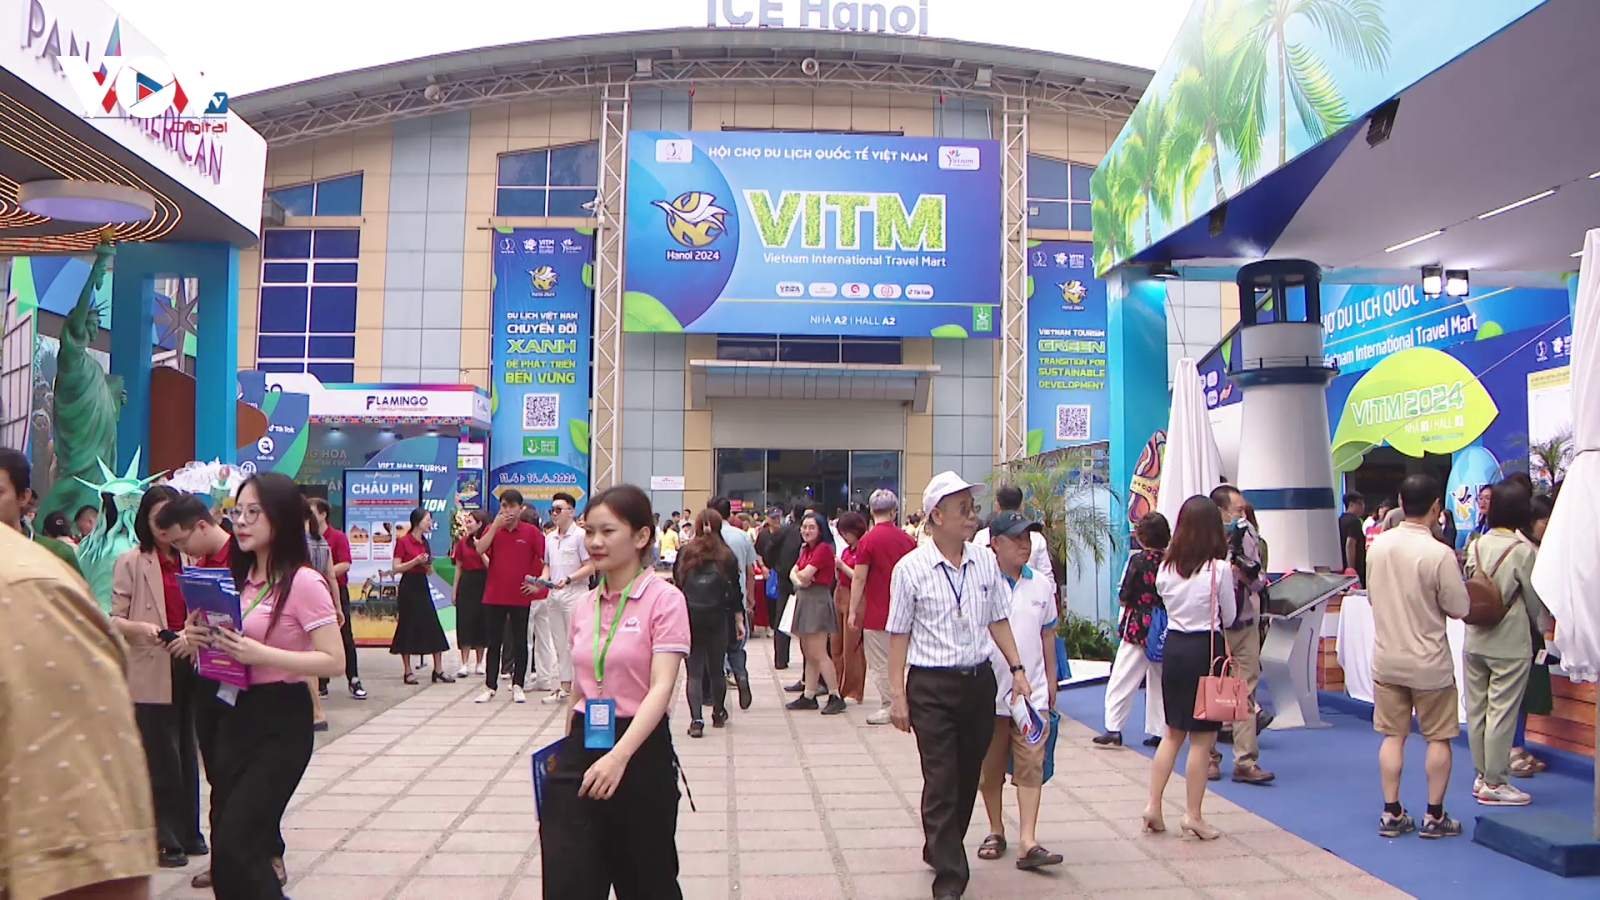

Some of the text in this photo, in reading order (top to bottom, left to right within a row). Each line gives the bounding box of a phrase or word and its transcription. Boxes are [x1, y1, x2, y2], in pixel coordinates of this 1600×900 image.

[799, 0, 919, 35] Hanoi
[708, 144, 929, 164] HỘI CHỢ DU LỊCH QUỐC TẾ VIỆT NAM
[742, 188, 946, 252] VITM
[666, 251, 720, 261] Hanoi 2024
[763, 253, 947, 268] Vietnam International Travel Mart
[507, 312, 519, 320] DU
[560, 312, 578, 320] NAM
[810, 314, 832, 325] NHÀ
[834, 315, 848, 325] A2
[855, 316, 880, 326] HALL
[882, 316, 897, 326] A2
[1337, 304, 1353, 331] DU
[1355, 294, 1382, 329] LỊCH
[1038, 328, 1106, 337] VIETNAM TOURISM
[1323, 311, 1478, 369] ietnam International Travel Mart
[506, 339, 577, 354] XANH
[1038, 339, 1106, 354] GREEN
[1039, 357, 1106, 367] TRANSITION FOR
[1038, 367, 1106, 378] SUSTAINABLE
[1038, 380, 1105, 390] DEVELOPMENT
[366, 395, 429, 410] FLAMINGO
[1351, 380, 1466, 427] VITM 2024
[1433, 416, 1453, 430] HALL
[351, 480, 389, 494] CHÂU
[391, 483, 414, 494] PHI
